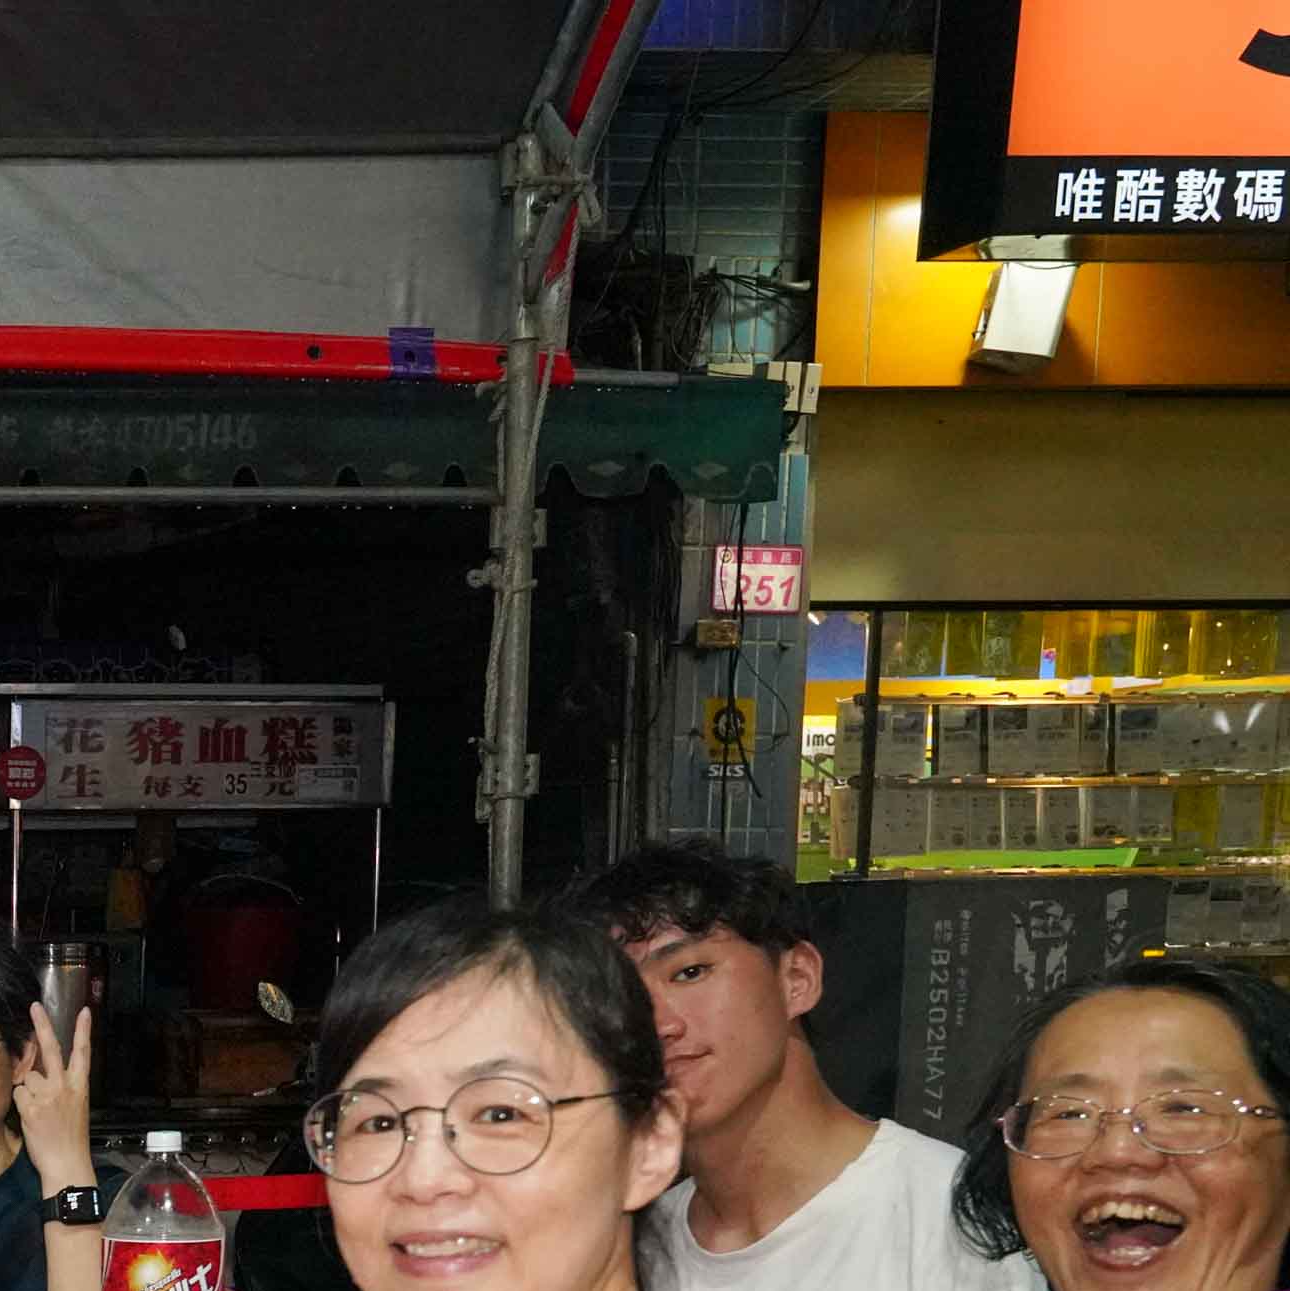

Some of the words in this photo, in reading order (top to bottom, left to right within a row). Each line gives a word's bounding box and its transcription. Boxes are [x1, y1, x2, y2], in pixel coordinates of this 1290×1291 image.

[1054, 168, 1286, 223] 唯酷數碼
[125, 715, 319, 766] 豬血糕
[224, 773, 248, 795] 35
